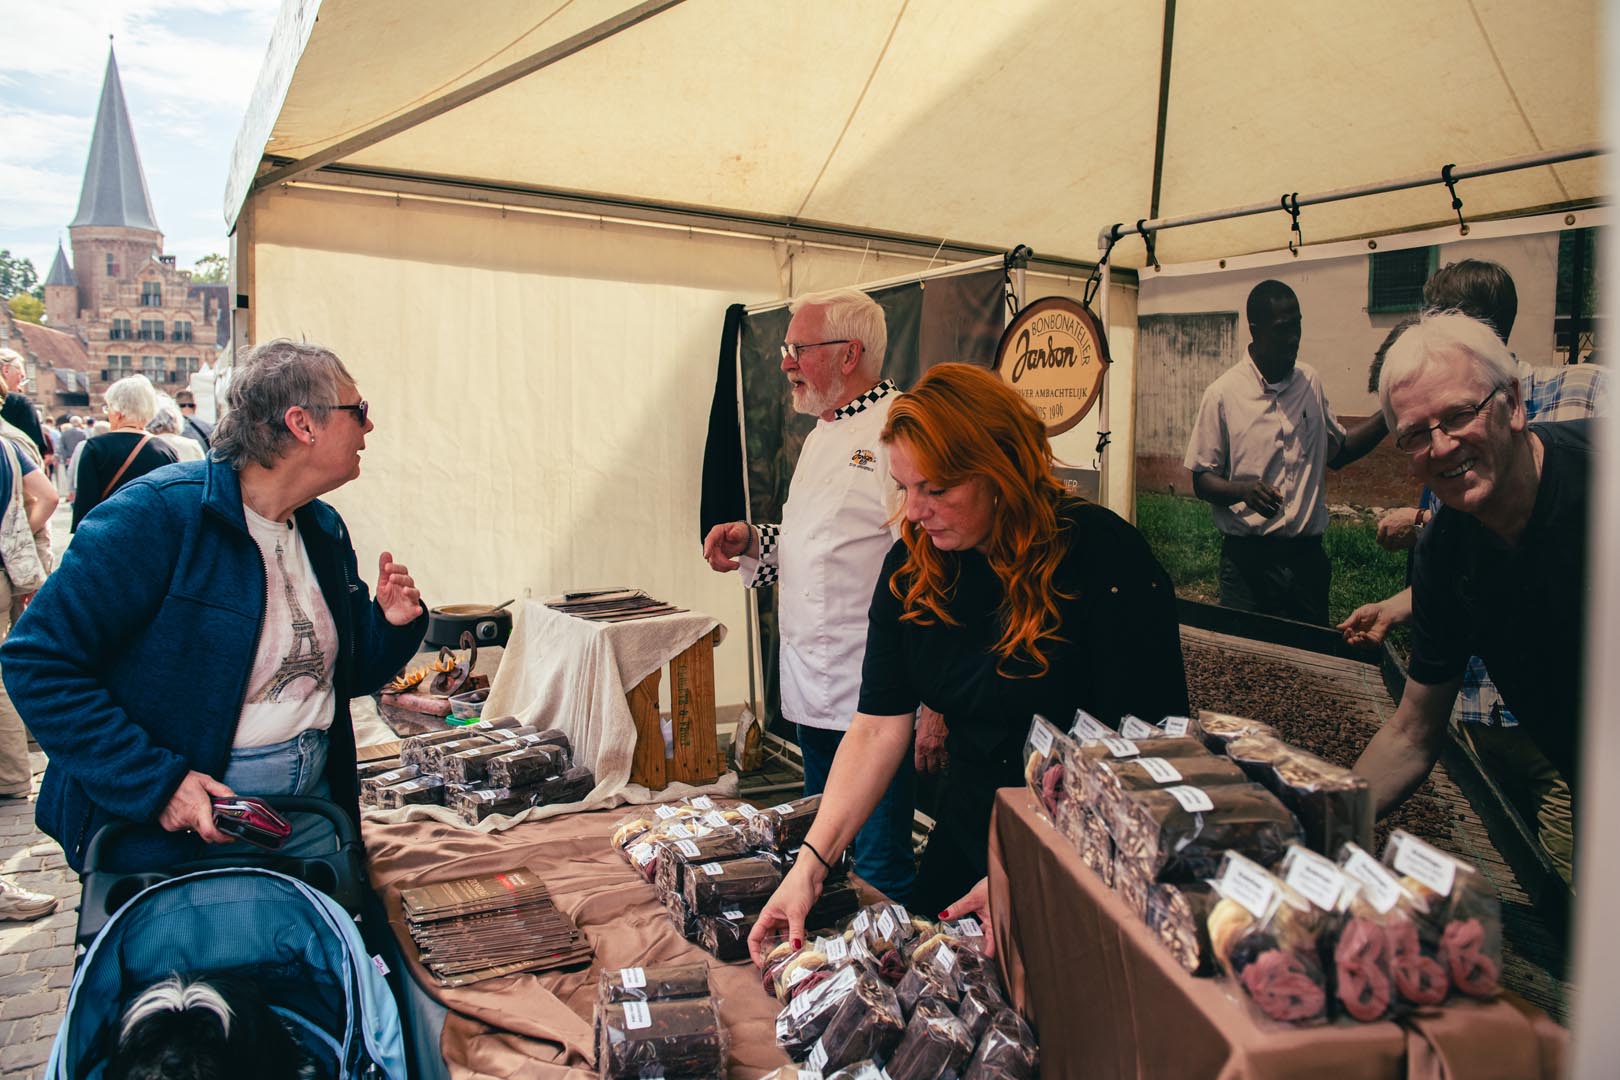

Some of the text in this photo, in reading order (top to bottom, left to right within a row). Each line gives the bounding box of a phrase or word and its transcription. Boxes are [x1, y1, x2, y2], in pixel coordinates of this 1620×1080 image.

[1031, 313, 1092, 366] BONBONATELIER
[1034, 387, 1088, 400] AMBACHTELIJK
[1049, 403, 1064, 420] 1996
